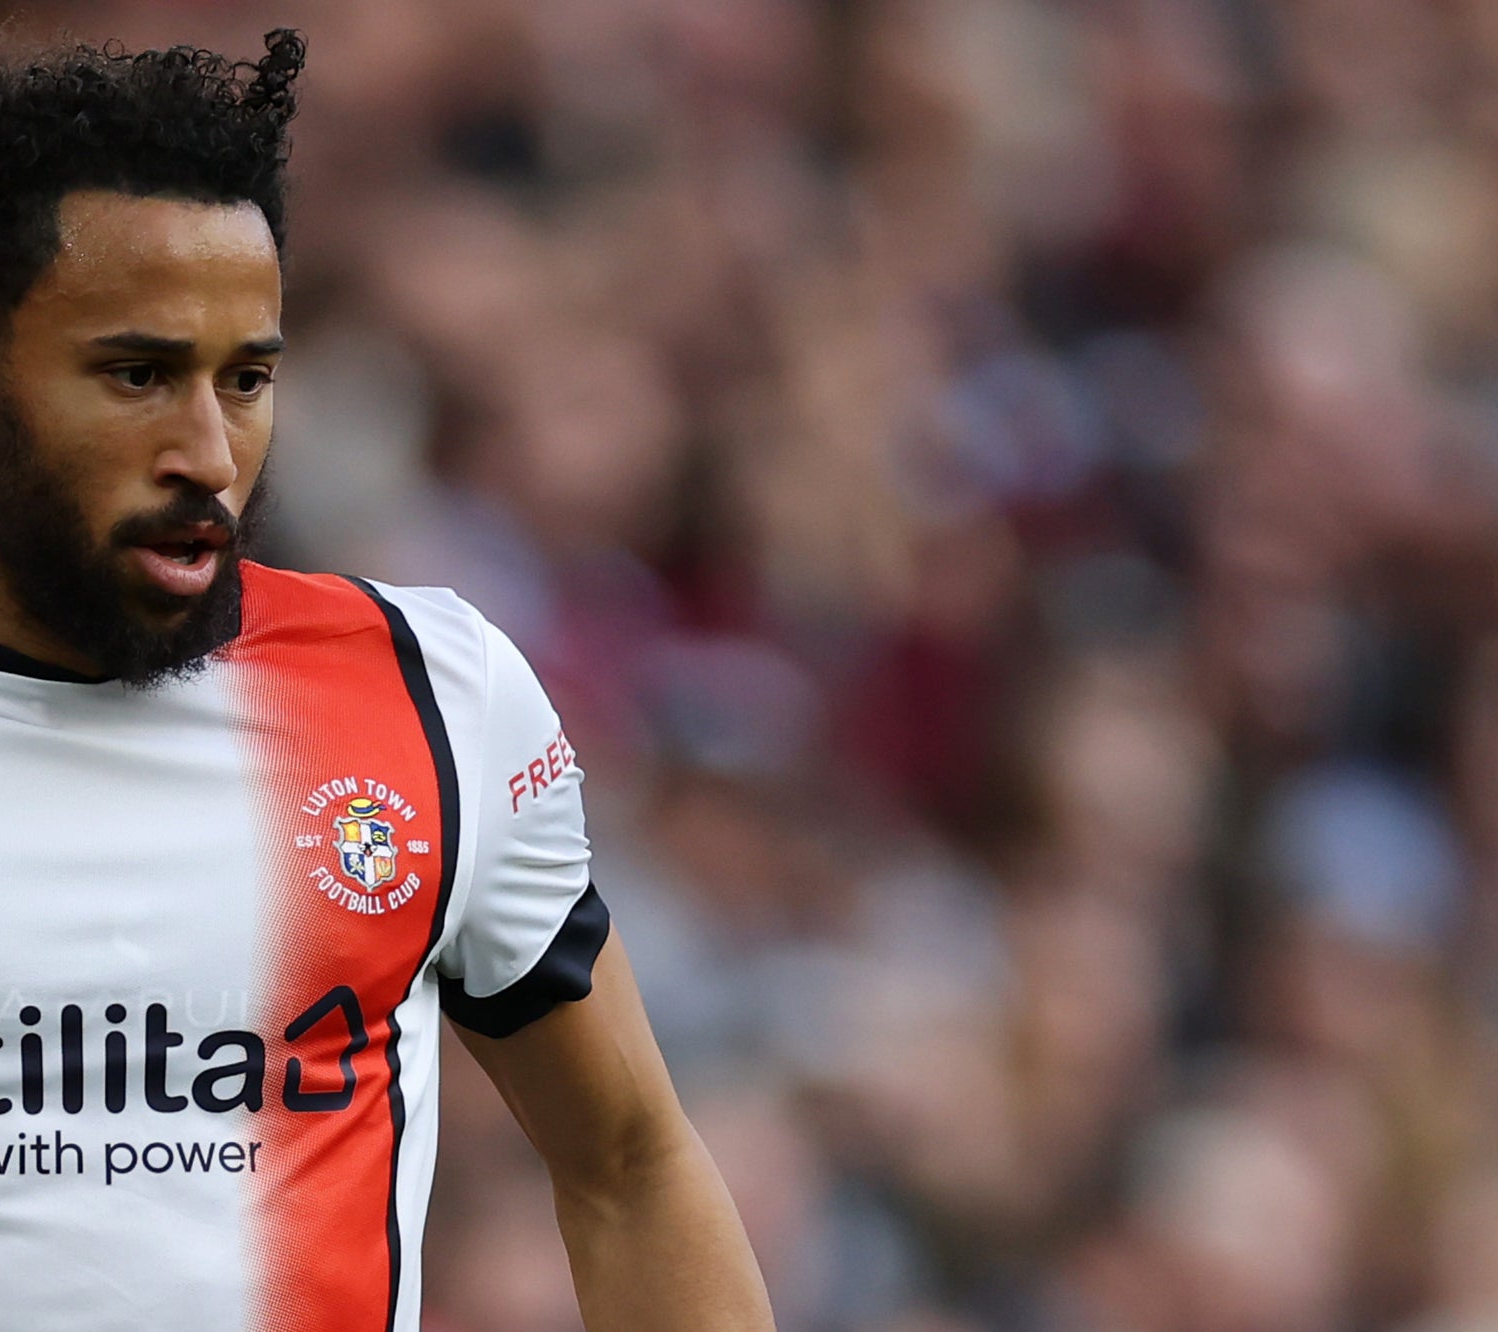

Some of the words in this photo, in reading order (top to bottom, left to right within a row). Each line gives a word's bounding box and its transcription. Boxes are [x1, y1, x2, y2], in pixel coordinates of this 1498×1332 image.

[302, 776, 358, 816] LUTON
[364, 779, 416, 821] TOWN
[296, 835, 322, 848] EST
[309, 866, 385, 914] FOOTBALL
[388, 873, 421, 909] CLUB
[105, 1142, 261, 1186] power
